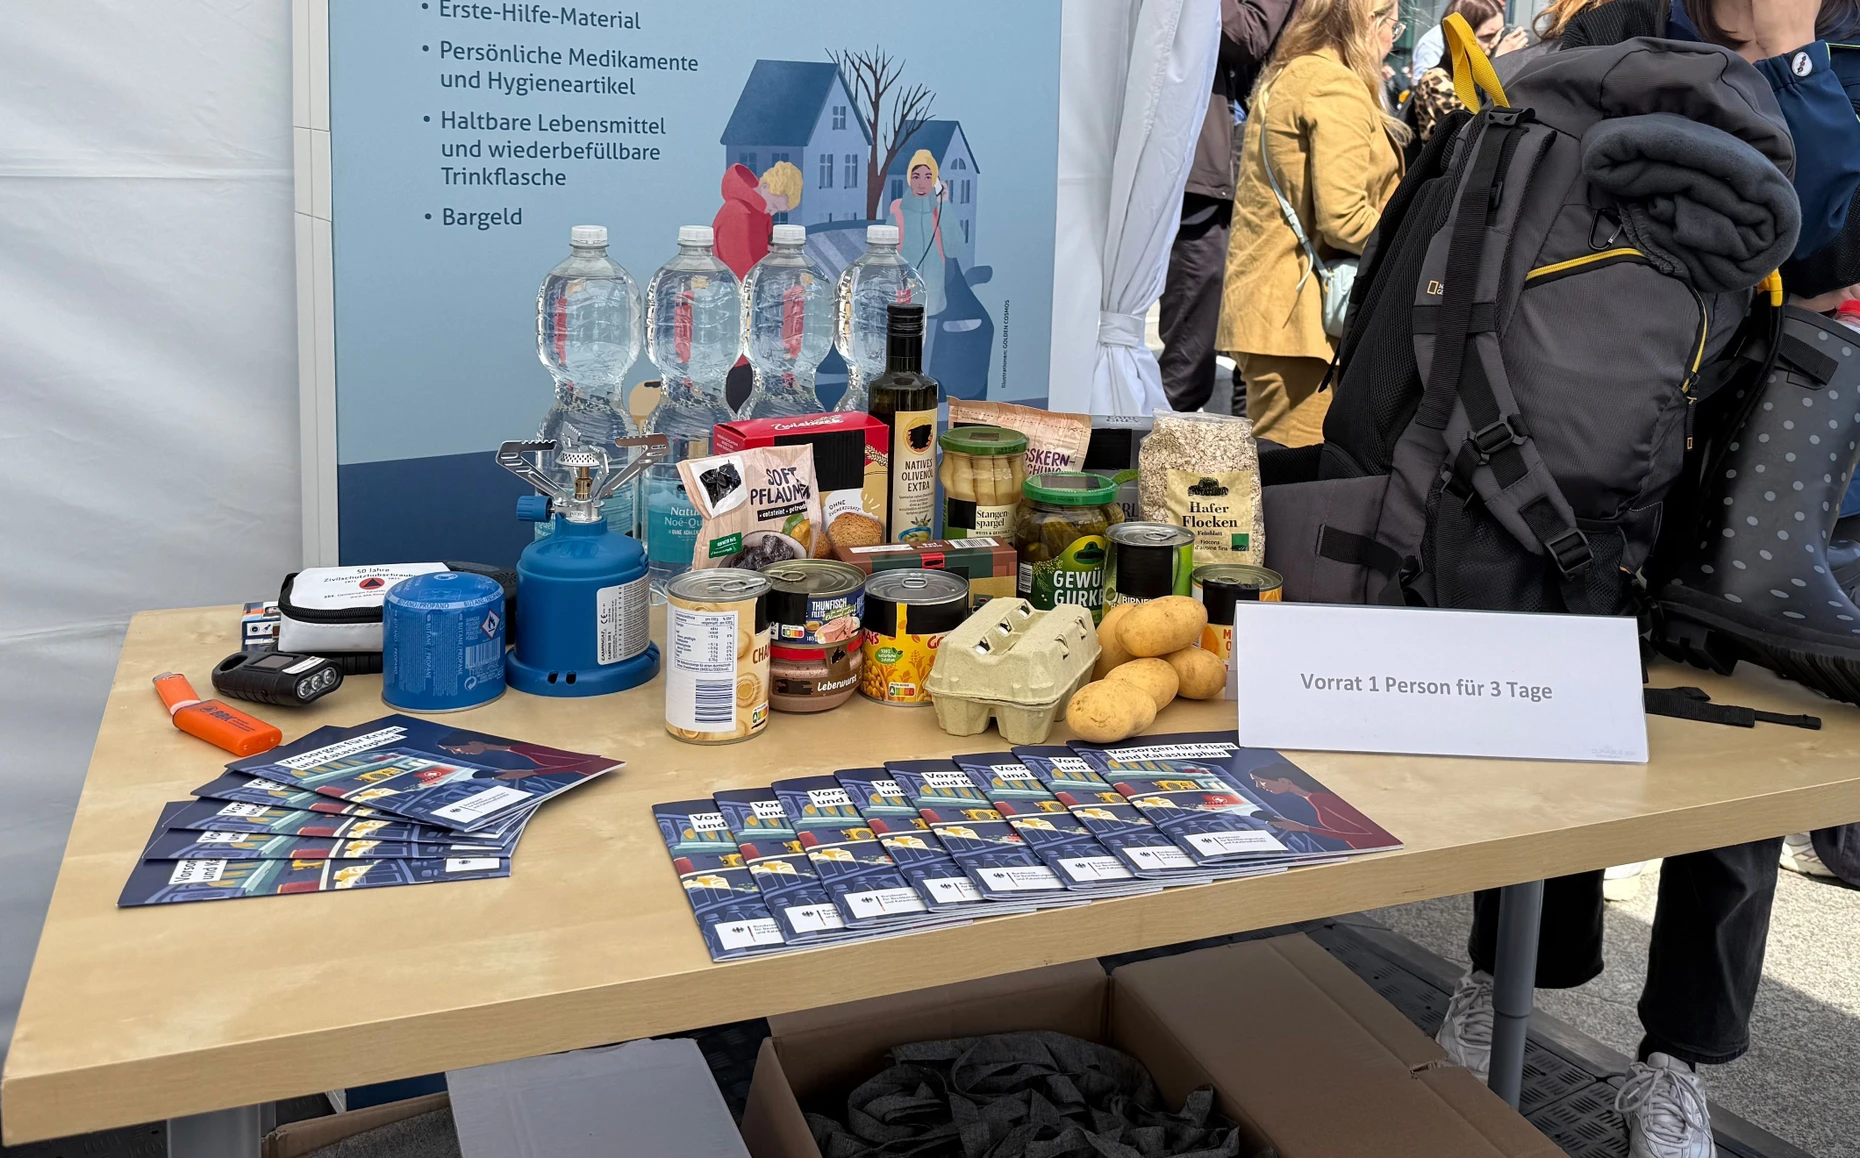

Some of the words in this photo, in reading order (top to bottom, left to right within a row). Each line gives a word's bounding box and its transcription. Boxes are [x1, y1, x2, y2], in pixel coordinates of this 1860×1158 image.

[439, 0, 642, 30] Erste-Hilfe-Material
[440, 41, 562, 66] Persönliche
[568, 47, 699, 72] Medikamente
[440, 71, 481, 90] und
[488, 72, 636, 96] Hygieneartikel
[441, 110, 532, 132] Haltbare
[538, 114, 666, 135] Lebensmittel
[441, 140, 482, 158] und
[488, 141, 661, 161] wiederbefüllbare
[441, 167, 567, 186] Trinkflasche
[442, 207, 523, 230] Bargeld
[904, 458, 933, 471] NATIVES
[765, 466, 798, 487] SOFT
[901, 467, 934, 482] OLIVENÖL
[907, 480, 930, 492] EXTRA
[828, 499, 846, 510] OHNE
[1189, 501, 1230, 514] Hafer
[976, 509, 1010, 520] Stangen-
[1182, 515, 1238, 528] Flocken
[664, 516, 703, 529] Noé-Qu
[976, 518, 1005, 529] spargel
[324, 573, 417, 583] Zivilschutzhubschraub
[1053, 567, 1105, 589] GEWÜ
[811, 597, 848, 611] THUNFISCH
[752, 642, 770, 665] CHA
[817, 674, 858, 692] Leberwurst
[1300, 673, 1362, 692] Vorrat
[1368, 676, 1380, 692] 1
[1386, 676, 1451, 696] Person
[1456, 678, 1485, 697] für
[1489, 681, 1502, 698] 3
[1506, 681, 1553, 703] Tage
[280, 742, 347, 765] Vorsorgen
[361, 726, 402, 741] Krisen
[320, 734, 401, 761] Katastrophen
[1108, 745, 1174, 756] Vorsorgen
[1174, 744, 1193, 752] für
[1195, 743, 1236, 751] Krisen
[1142, 750, 1226, 759] Katastrophen
[816, 797, 845, 805] und
[697, 821, 727, 829] und
